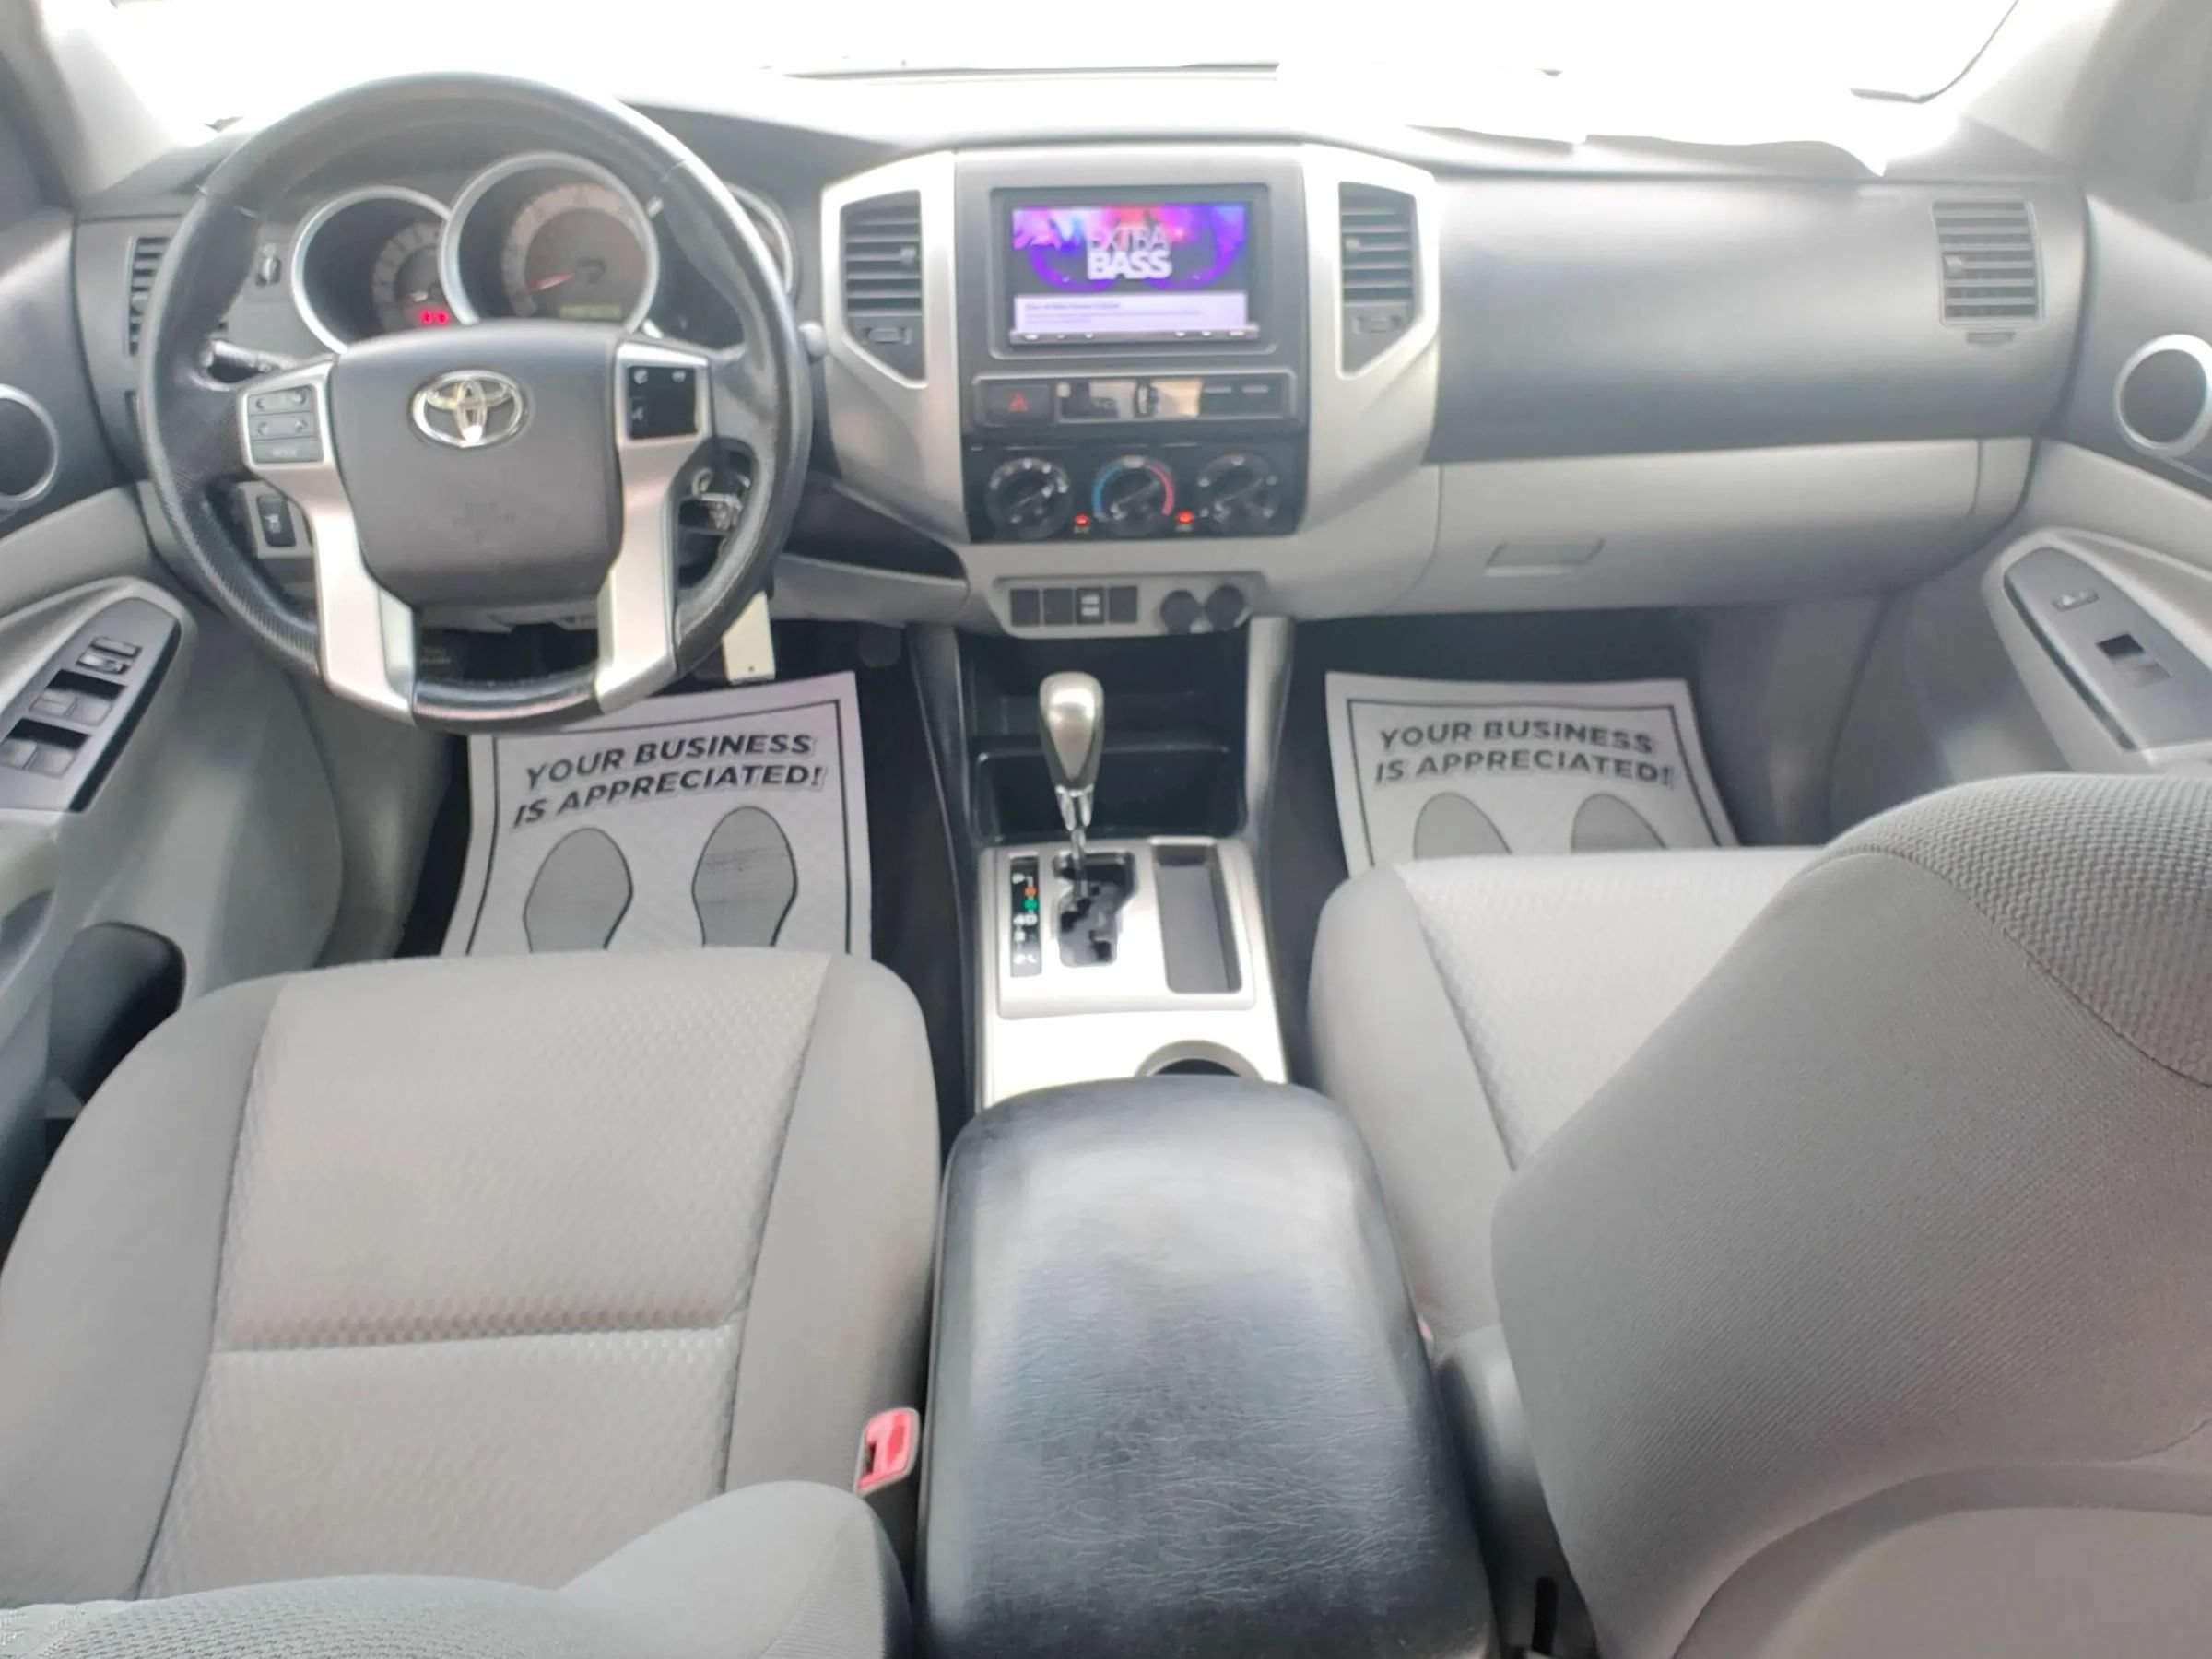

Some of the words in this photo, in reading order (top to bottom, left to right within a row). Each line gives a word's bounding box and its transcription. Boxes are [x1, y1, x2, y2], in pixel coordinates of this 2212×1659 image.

[1086, 225, 1170, 252] EXTRA
[1087, 250, 1172, 279] BASS
[1380, 723, 1473, 751] YOUR
[1483, 720, 1653, 755] BUSINESS
[526, 749, 625, 790] YOUR
[633, 734, 812, 767] BUSINESS
[1375, 759, 1405, 784] IS
[1416, 749, 1675, 787] APPRECIATED!
[513, 798, 550, 829] IS
[557, 764, 824, 816] APPRECIATED!
